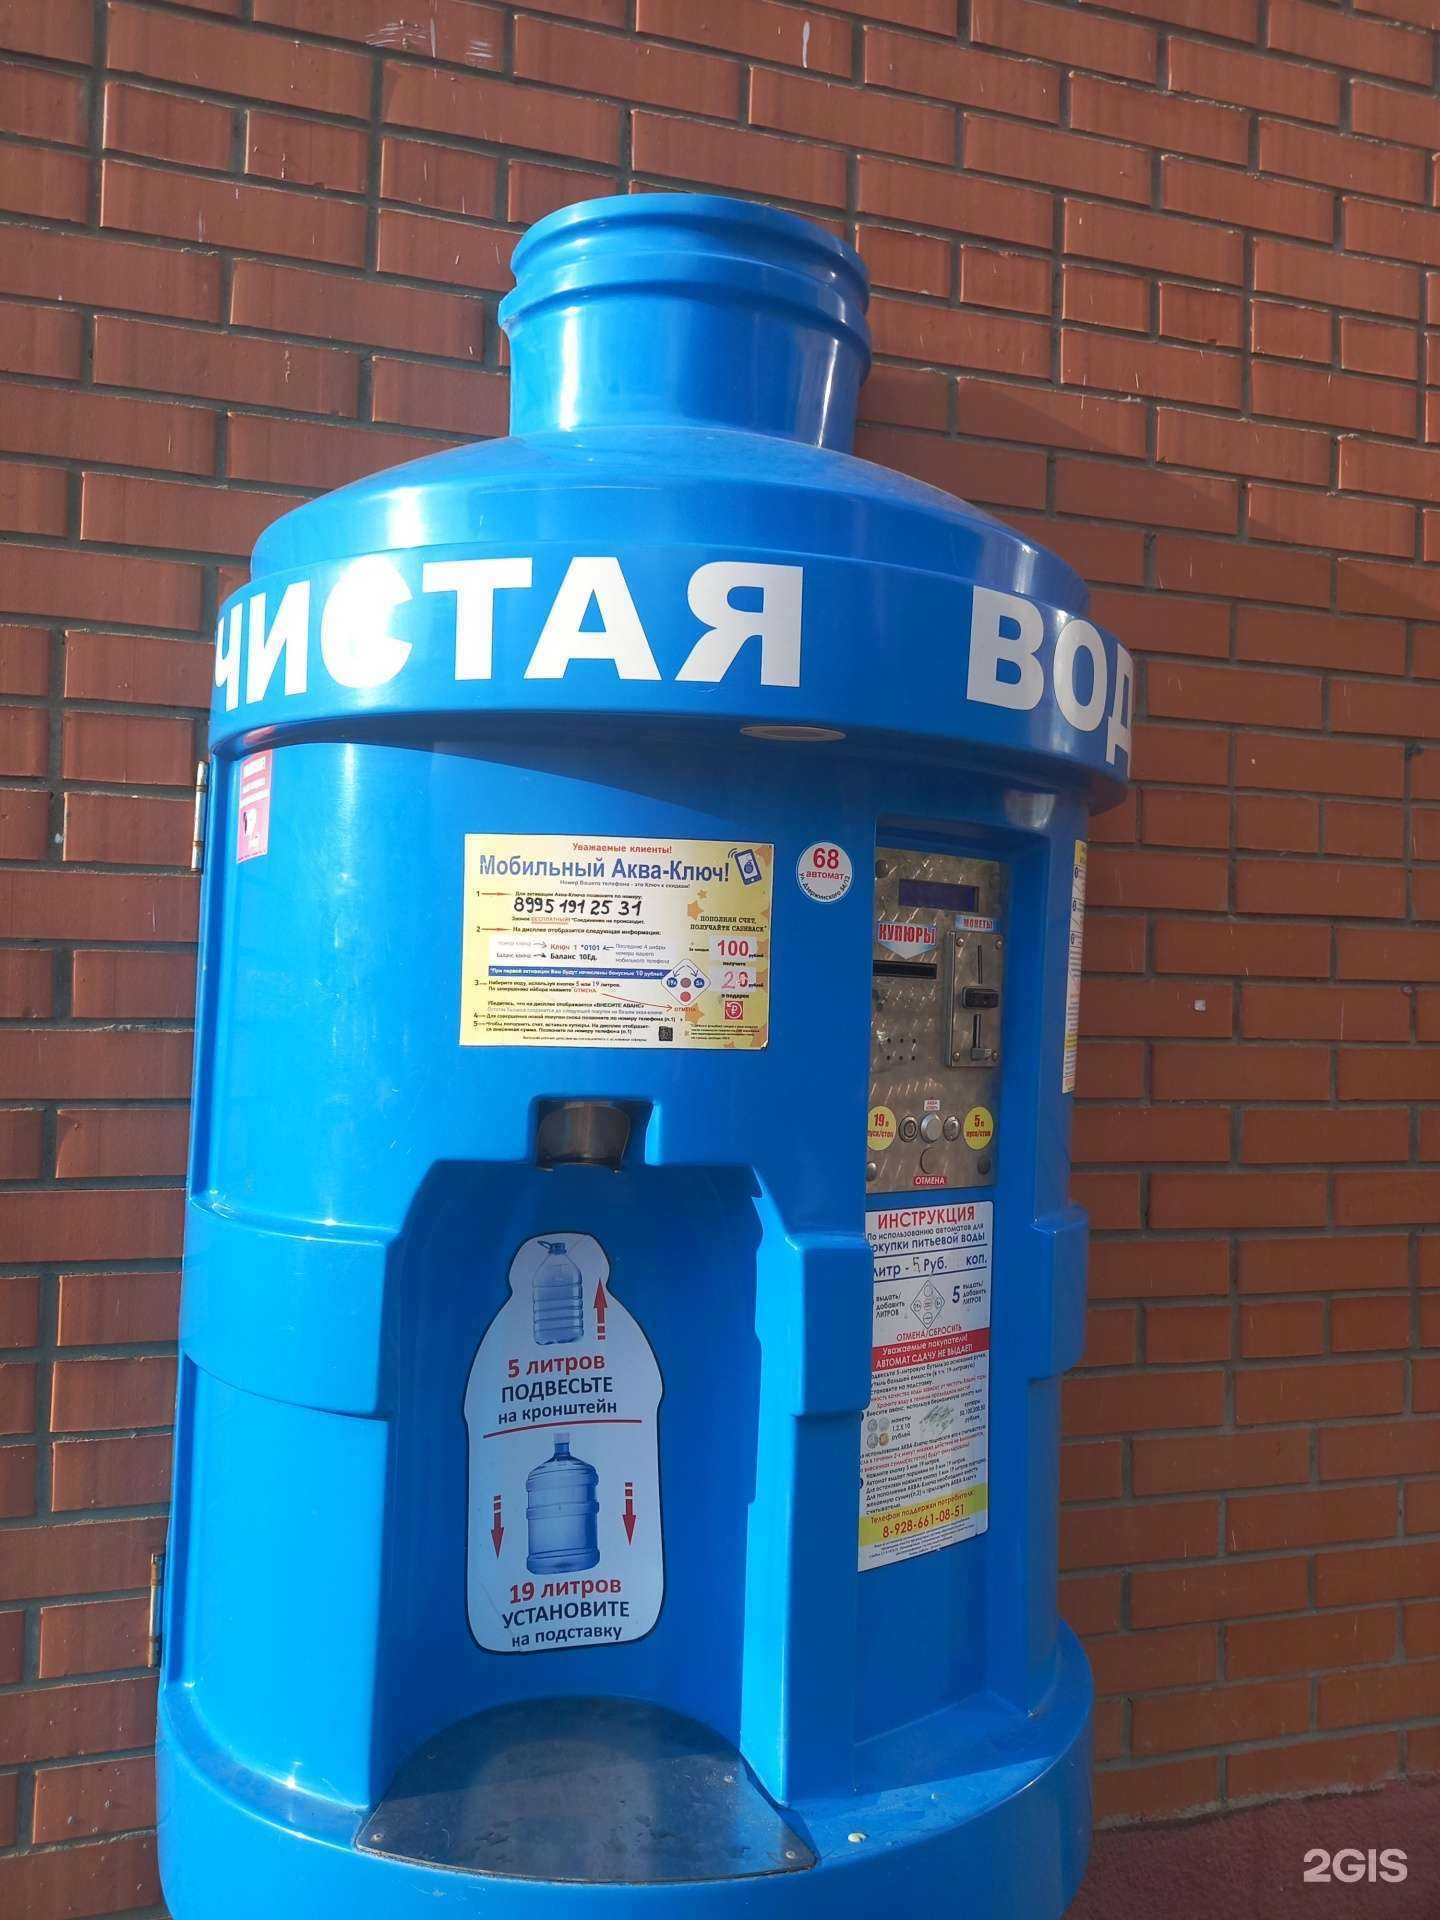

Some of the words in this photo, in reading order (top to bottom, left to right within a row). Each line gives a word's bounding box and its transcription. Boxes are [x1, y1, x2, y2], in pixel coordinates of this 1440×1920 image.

[214, 556, 804, 712] ЧИСТАЯ
[573, 842, 627, 854] Уважаемые
[629, 844, 672, 854] клиенты!
[813, 847, 839, 869] 68
[480, 854, 605, 878] Мобильный
[611, 858, 729, 882] Аква-Ключ!
[805, 871, 844, 880] автомат
[590, 900, 613, 916] 25
[618, 900, 642, 916] 31
[962, 917, 993, 929] МОНЕТЫ
[878, 923, 936, 944] КУПЮРЫ
[717, 940, 749, 956] 100
[915, 1175, 945, 1186] ОТМЕНА
[878, 1206, 975, 1230] ИНСТРУКЦИЯ
[878, 1228, 934, 1241] использованию
[935, 1223, 972, 1235] автоматов
[972, 1222, 984, 1232] для
[871, 1240, 909, 1254] окупки
[912, 1232, 959, 1249] питьевой
[961, 1232, 985, 1244] воды
[966, 1254, 987, 1266] коп.
[952, 1285, 960, 1303] 5
[963, 1296, 982, 1305] ЛИТРОВ
[876, 1301, 906, 1312] добавить
[876, 1308, 899, 1319] ЛИТРОВ
[896, 1323, 963, 1342] ОТМЕНА/СБРОСИТЬ
[882, 1341, 927, 1356] Уважаемые
[508, 1358, 520, 1379] 5
[525, 1355, 606, 1376] литров
[875, 1356, 911, 1369] АВТОМАТ
[911, 1351, 937, 1364] СДАЧУ
[937, 1348, 947, 1358] НЕ
[501, 1376, 613, 1404] ПОДВЕСЬТЕ
[498, 1412, 517, 1425] на
[522, 1398, 617, 1423] кронштейн
[892, 1415, 912, 1423] монеты
[892, 1431, 911, 1441] рублей
[871, 1510, 901, 1525] Телефон
[882, 1503, 965, 1539] 8-928-661-08-51
[509, 1582, 535, 1605] 19
[540, 1579, 622, 1599] литров
[501, 1601, 630, 1630] УСТАНОВИТЕ
[511, 1633, 530, 1648] на
[535, 1624, 622, 1644] подставку
